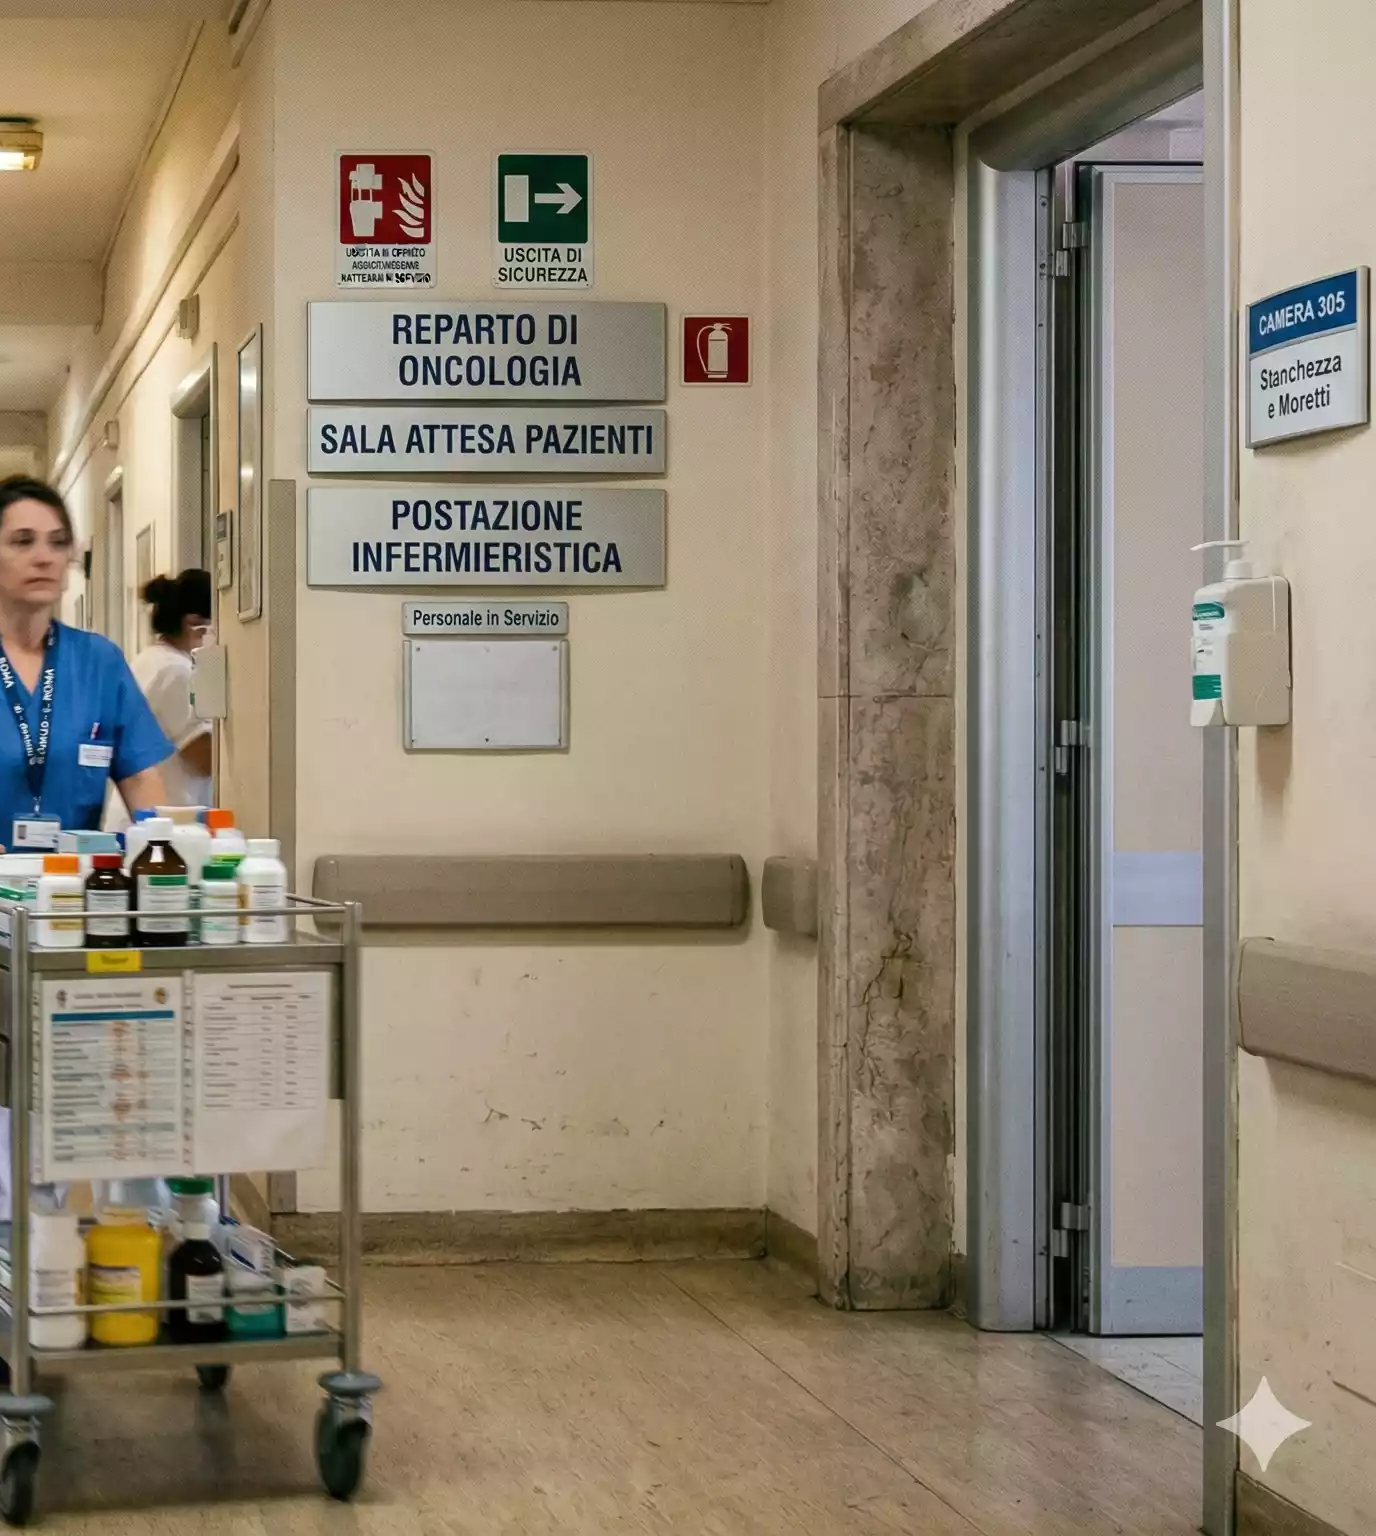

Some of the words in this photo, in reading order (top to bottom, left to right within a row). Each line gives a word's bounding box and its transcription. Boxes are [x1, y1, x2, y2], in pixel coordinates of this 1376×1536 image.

[504, 247, 560, 263] USCITA
[566, 247, 582, 263] DI
[498, 267, 588, 283] SICUREZZA
[1259, 300, 1315, 336] CAMERA
[1317, 291, 1346, 318] 305
[392, 314, 536, 346] REPARTO
[548, 314, 578, 345] DI
[398, 355, 582, 387] ONCOLOGIA
[1260, 354, 1342, 391] Stanchezza
[1268, 402, 1275, 419] e
[1279, 384, 1330, 417] Moretti
[320, 424, 397, 455] SALA
[405, 423, 516, 455] ATTESA
[526, 424, 653, 455] PAZIENTI
[392, 499, 583, 532] POSTAZIONE
[353, 541, 623, 574] INFERMIERISTICA
[413, 609, 483, 627] Personale
[486, 609, 500, 626] in
[504, 609, 560, 627] Servizio
